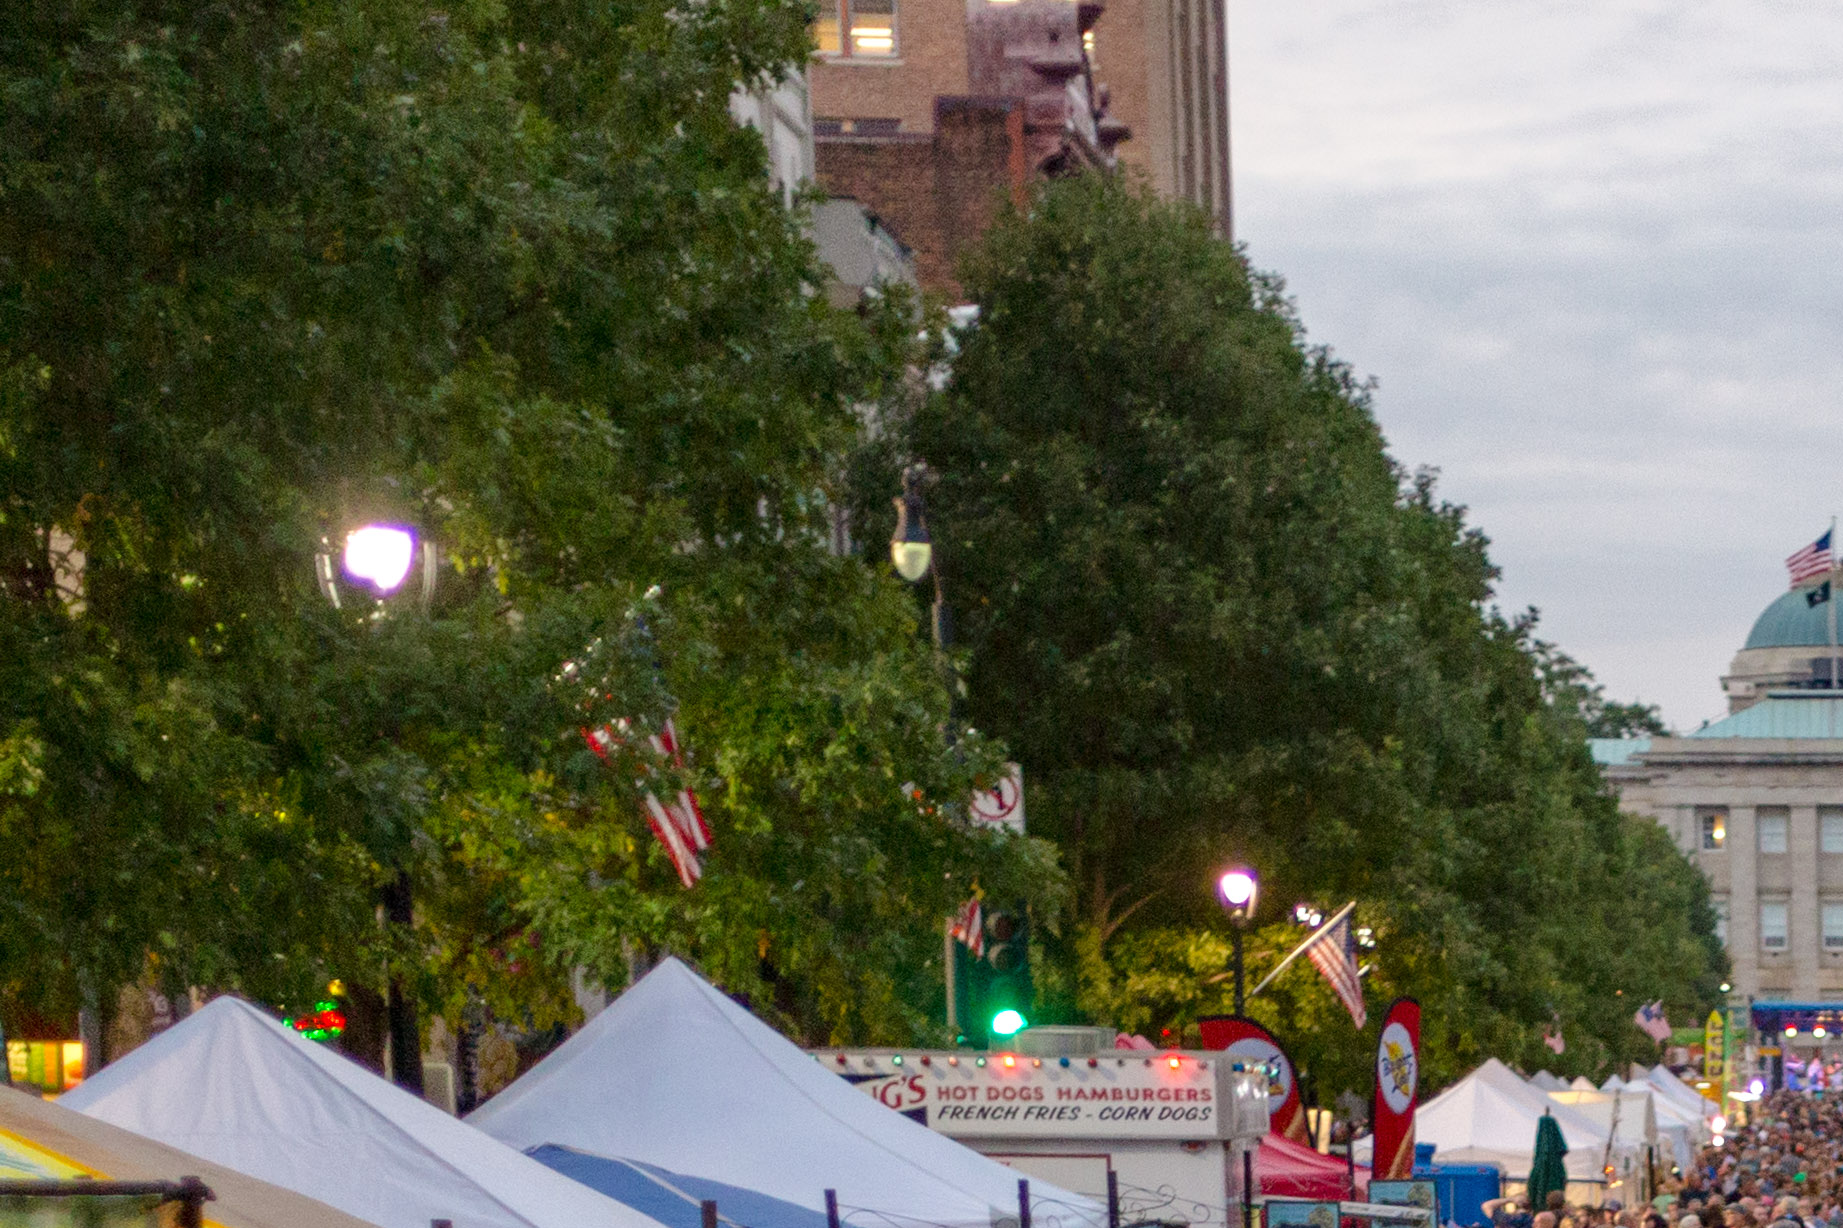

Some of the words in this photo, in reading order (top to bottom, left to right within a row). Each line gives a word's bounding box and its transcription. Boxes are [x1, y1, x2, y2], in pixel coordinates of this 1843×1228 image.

[937, 1086, 981, 1101] HOT
[985, 1086, 1044, 1101] DOGS
[1057, 1086, 1212, 1102] HAMBURGERS
[938, 1105, 1019, 1121] FRENCH
[1022, 1105, 1079, 1121] FRIES
[1099, 1105, 1152, 1121] CORN
[1158, 1105, 1212, 1121] DOGS
